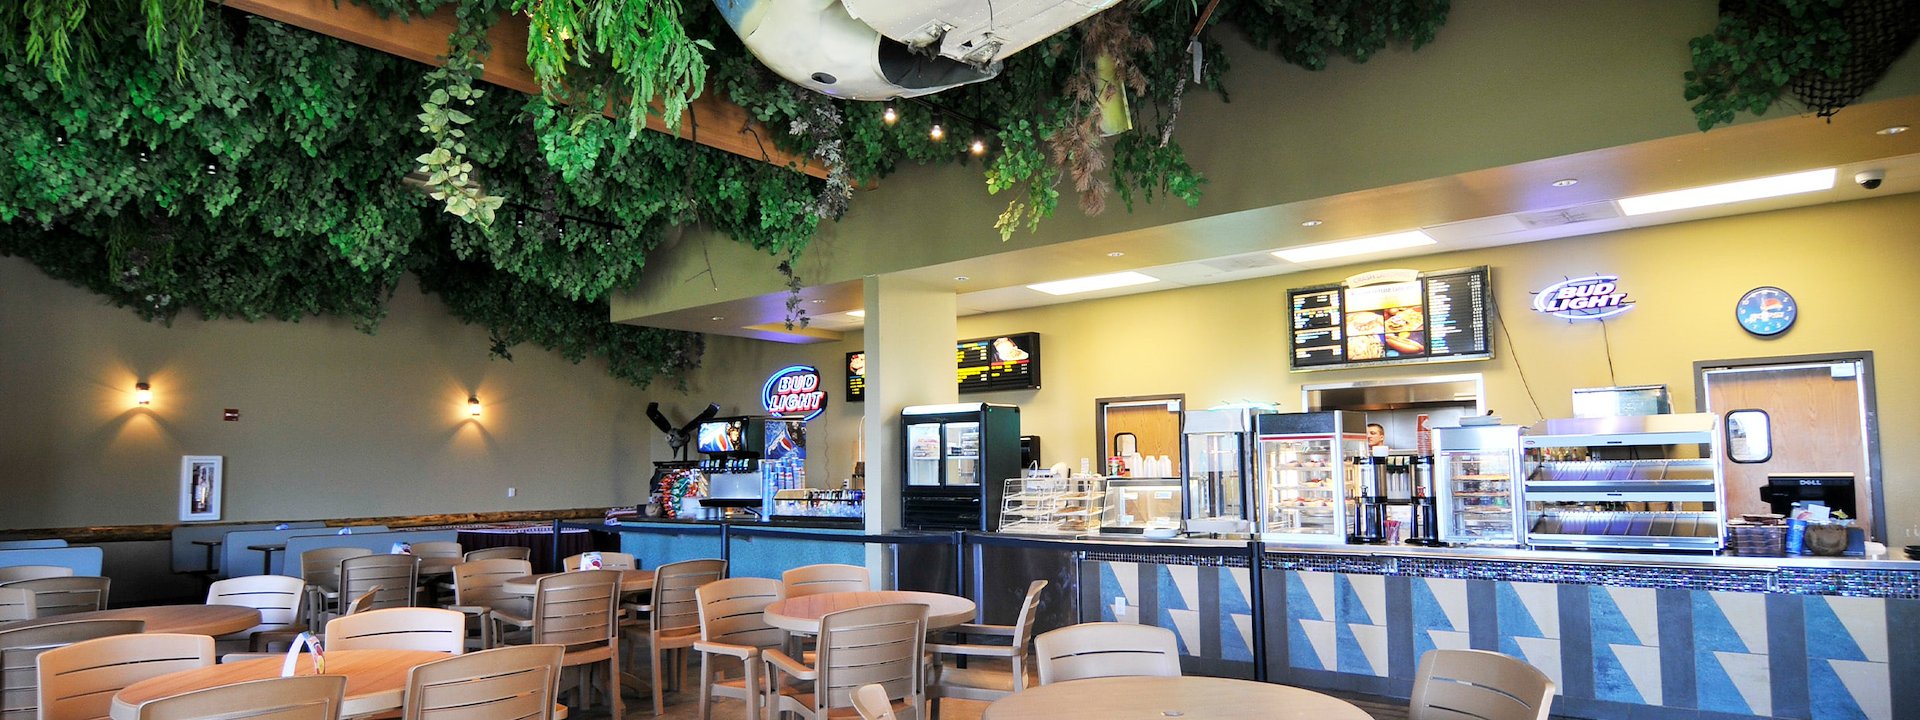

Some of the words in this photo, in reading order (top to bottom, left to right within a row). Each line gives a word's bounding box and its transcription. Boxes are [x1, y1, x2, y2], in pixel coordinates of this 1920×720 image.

[1557, 282, 1616, 299] BUD
[1545, 293, 1627, 312] LIGHT
[777, 373, 818, 394] BUD
[769, 391, 825, 412] LIGHT
